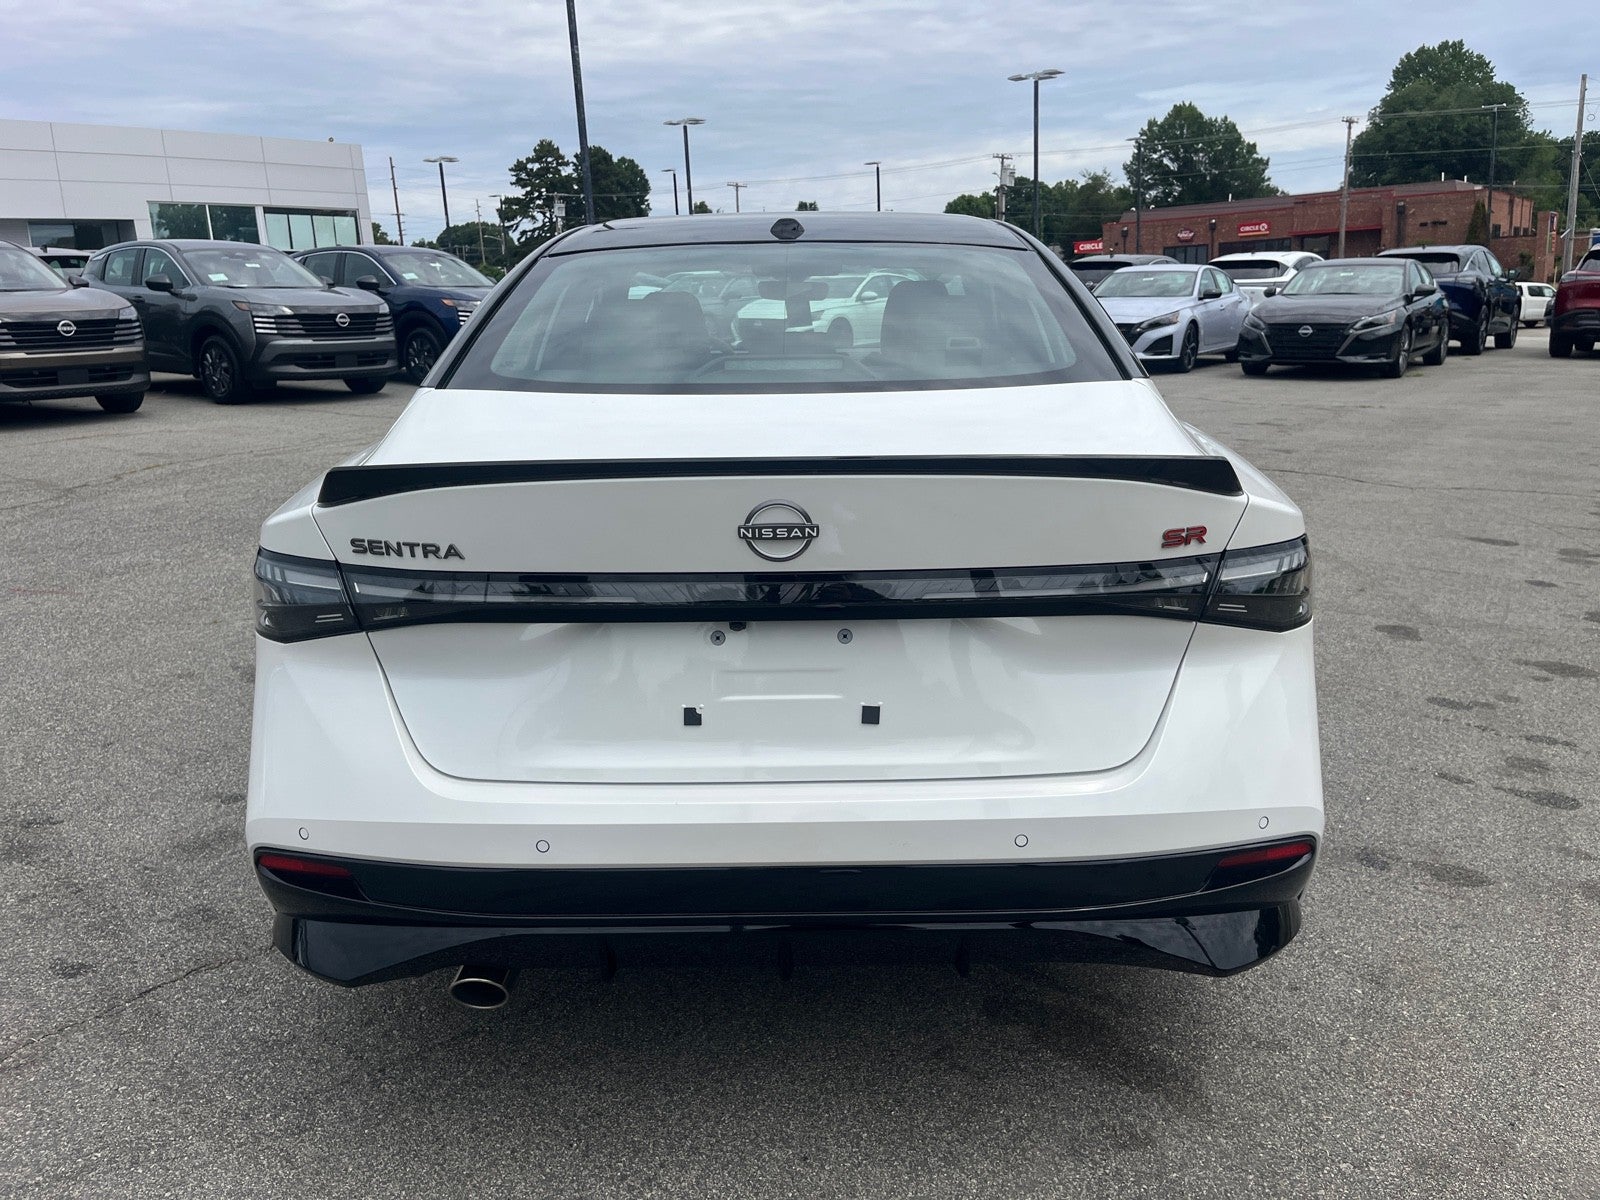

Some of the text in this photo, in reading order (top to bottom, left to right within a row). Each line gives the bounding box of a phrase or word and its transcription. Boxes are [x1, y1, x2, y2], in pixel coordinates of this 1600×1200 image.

[1078, 242, 1103, 250] CIRCLE
[740, 527, 817, 538] NISSAN
[1162, 526, 1207, 548] SR
[350, 538, 465, 560] SENTRA
